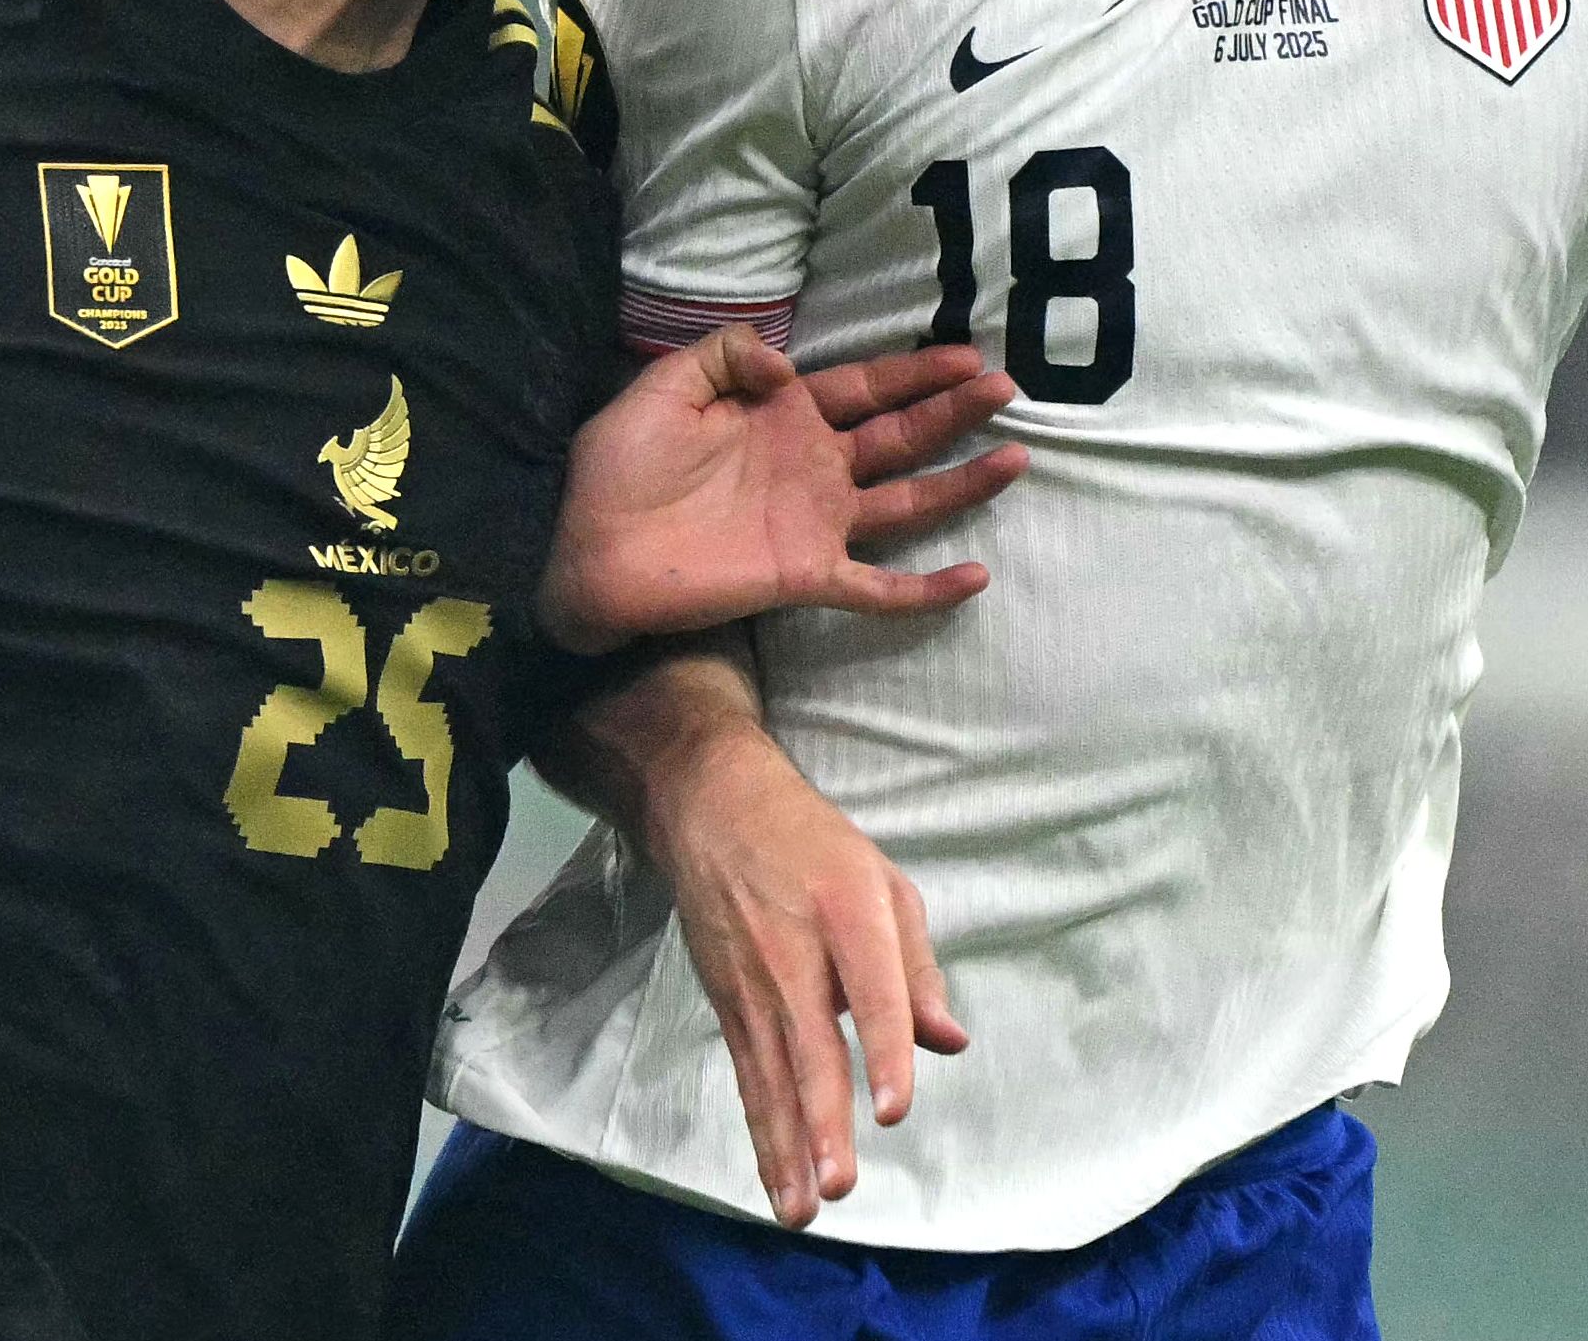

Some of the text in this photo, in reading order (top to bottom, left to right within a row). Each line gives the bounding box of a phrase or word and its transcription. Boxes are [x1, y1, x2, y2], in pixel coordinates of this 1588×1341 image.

[1213, 30, 1329, 64] 6 JULY 2025
[83, 266, 140, 285] GOLD
[910, 145, 1136, 406] 18
[92, 285, 133, 303] CUP
[77, 308, 148, 320] CHAMPIONS
[308, 538, 441, 578] MÉXICO
[222, 578, 494, 872] 25
